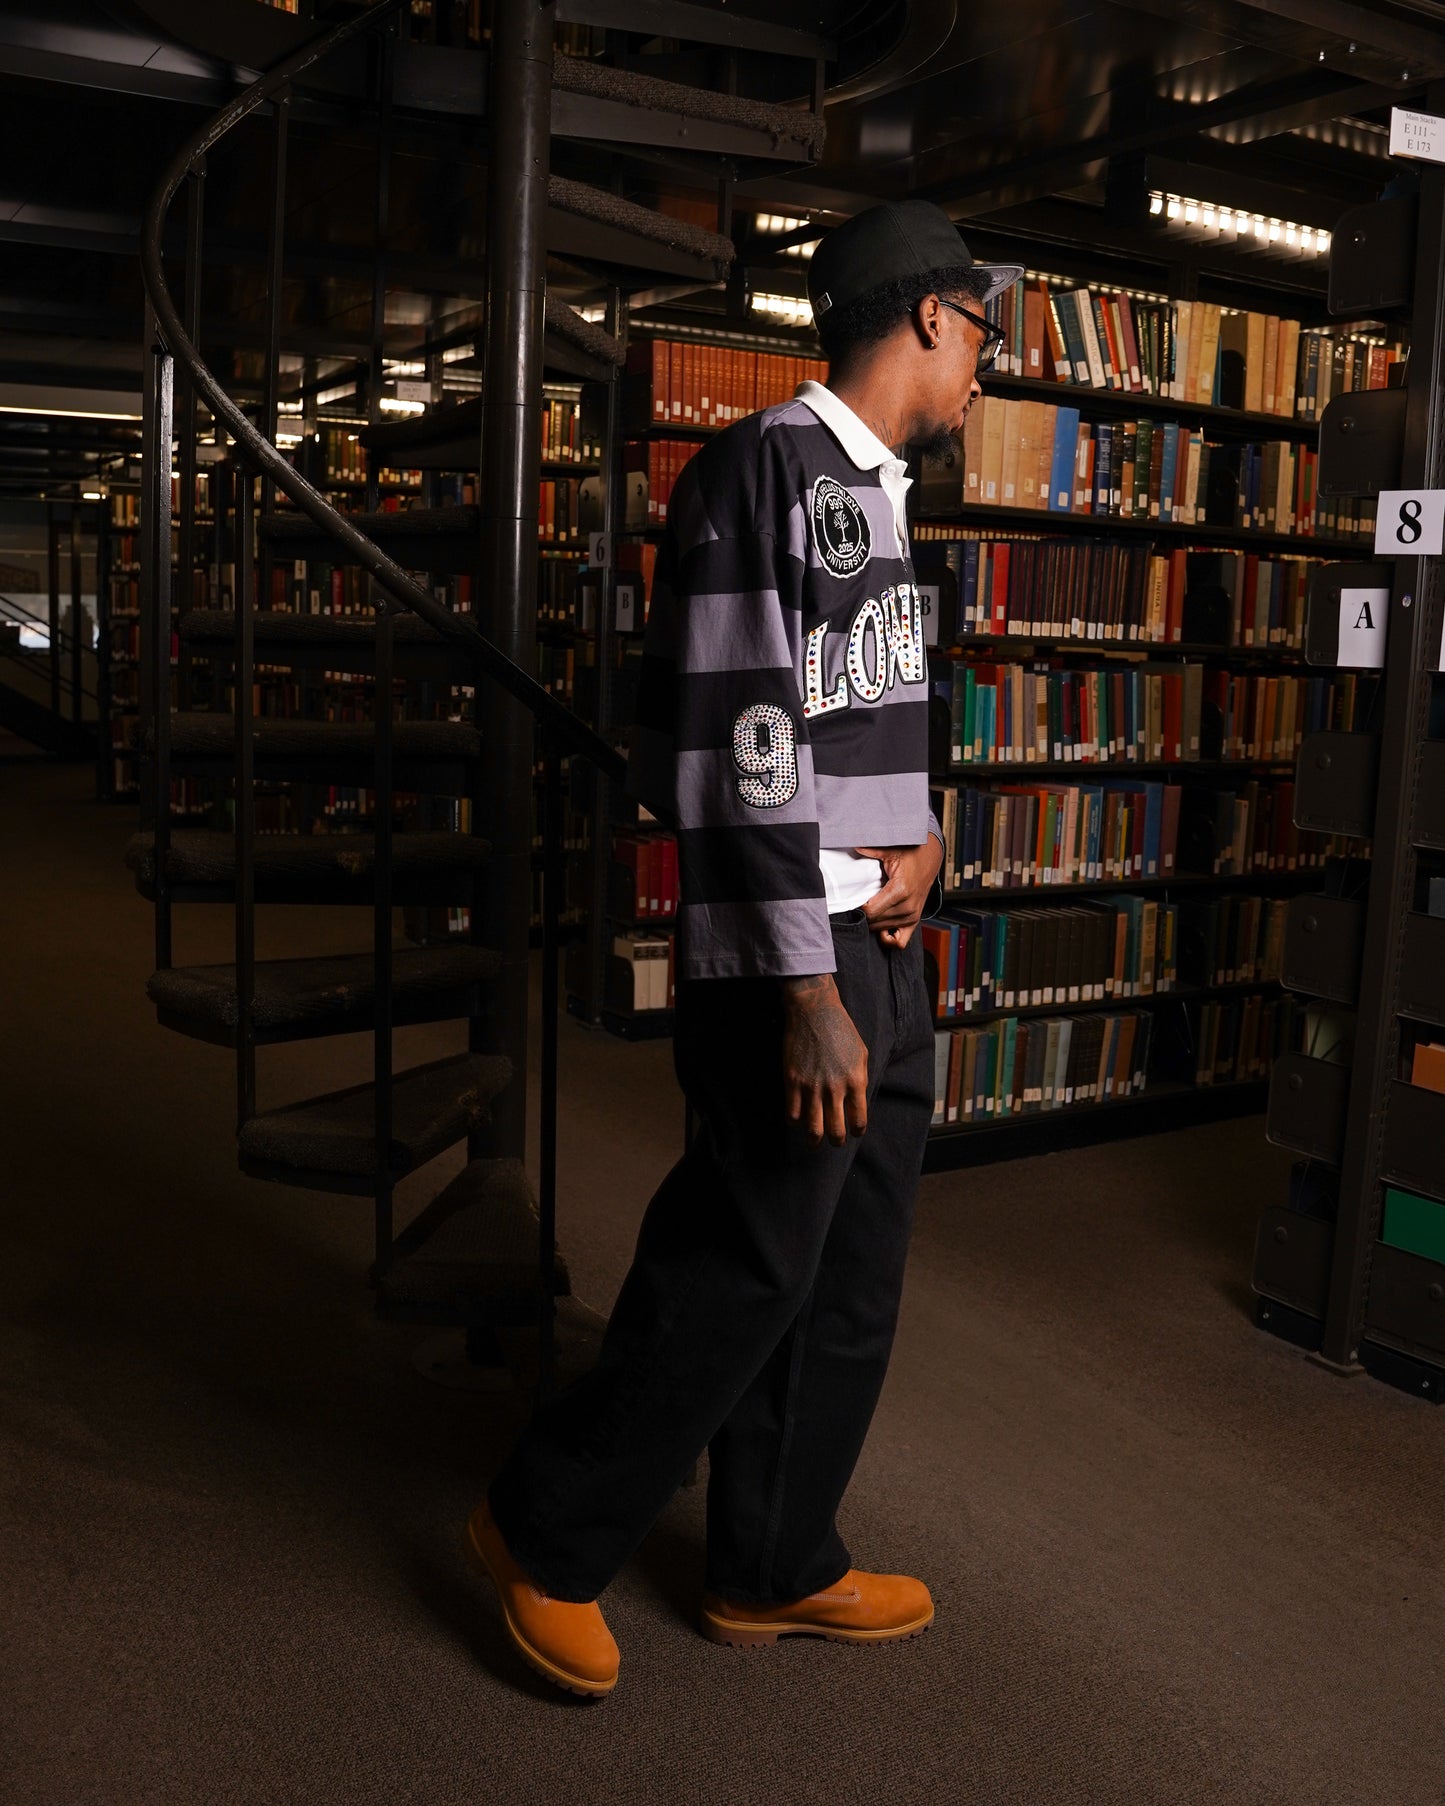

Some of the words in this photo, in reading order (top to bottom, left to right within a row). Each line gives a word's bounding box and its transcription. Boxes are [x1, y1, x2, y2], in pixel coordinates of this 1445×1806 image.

[1404, 123, 1411, 134] E
[1413, 125, 1428, 137] 111
[1407, 139, 1414, 149] E
[1416, 141, 1431, 152] 173
[827, 497, 844, 510] 999
[1396, 500, 1422, 544] 8
[596, 537, 605, 562] 6
[826, 541, 867, 570] UNIVERSITY
[838, 542, 854, 554] 2025
[622, 593, 630, 609] B
[919, 595, 931, 616] B
[1353, 601, 1376, 629] A
[732, 703, 798, 808] 9
